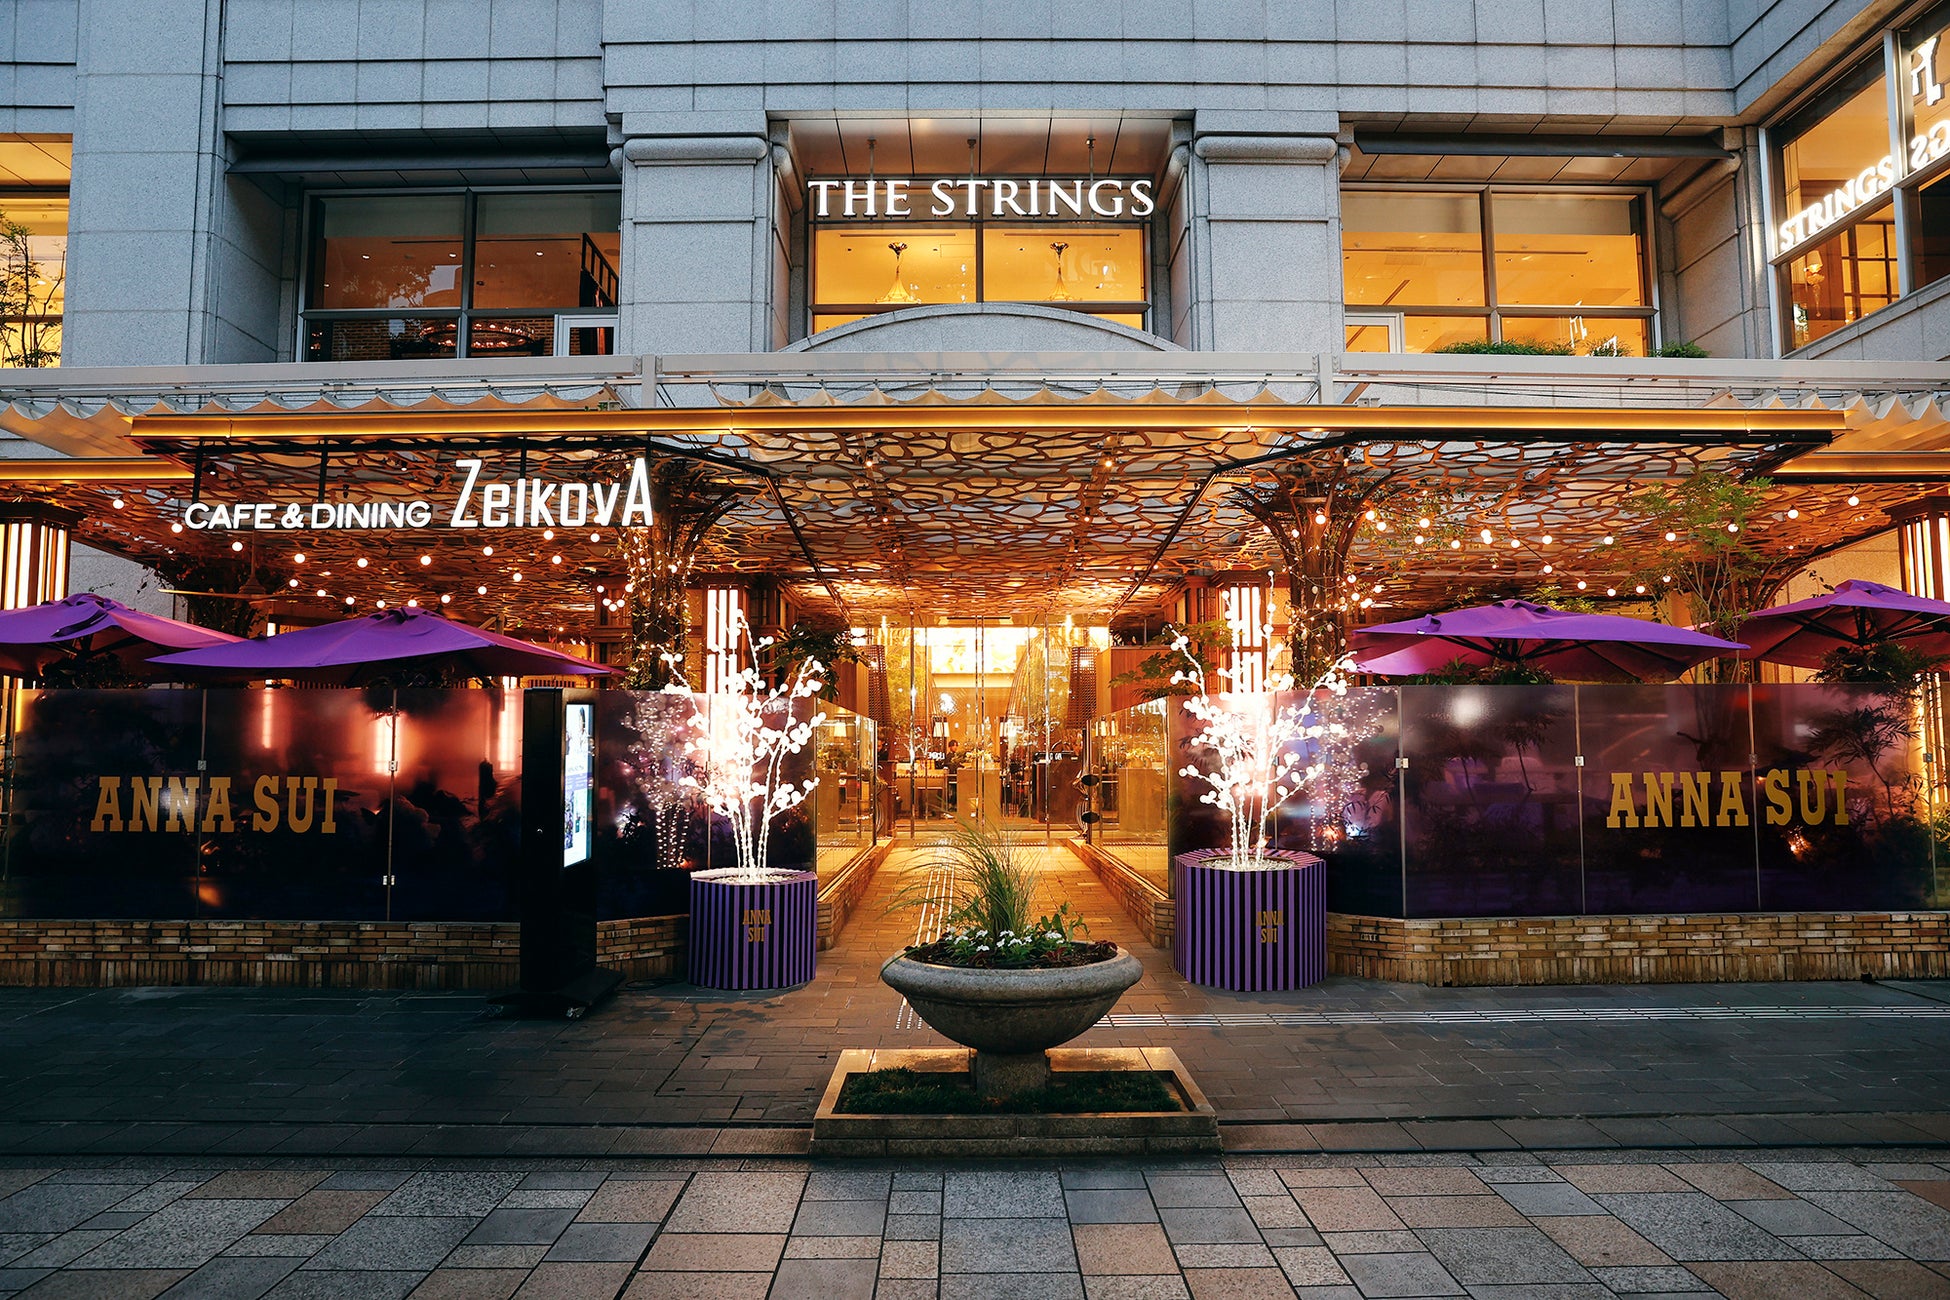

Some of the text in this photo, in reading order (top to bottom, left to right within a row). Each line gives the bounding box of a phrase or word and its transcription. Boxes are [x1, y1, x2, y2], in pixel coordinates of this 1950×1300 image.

[808, 179, 1154, 217] THE STRINGS
[1778, 155, 1893, 252] STRINGS
[184, 500, 432, 530] CAFE & DINING
[90, 775, 339, 834] ANNA SUI
[1606, 769, 1849, 828] ANNA SUI
[742, 909, 771, 925] ANNA
[1255, 910, 1284, 926] ANNA
[748, 926, 765, 943] SUI
[1260, 928, 1278, 943] SUI
